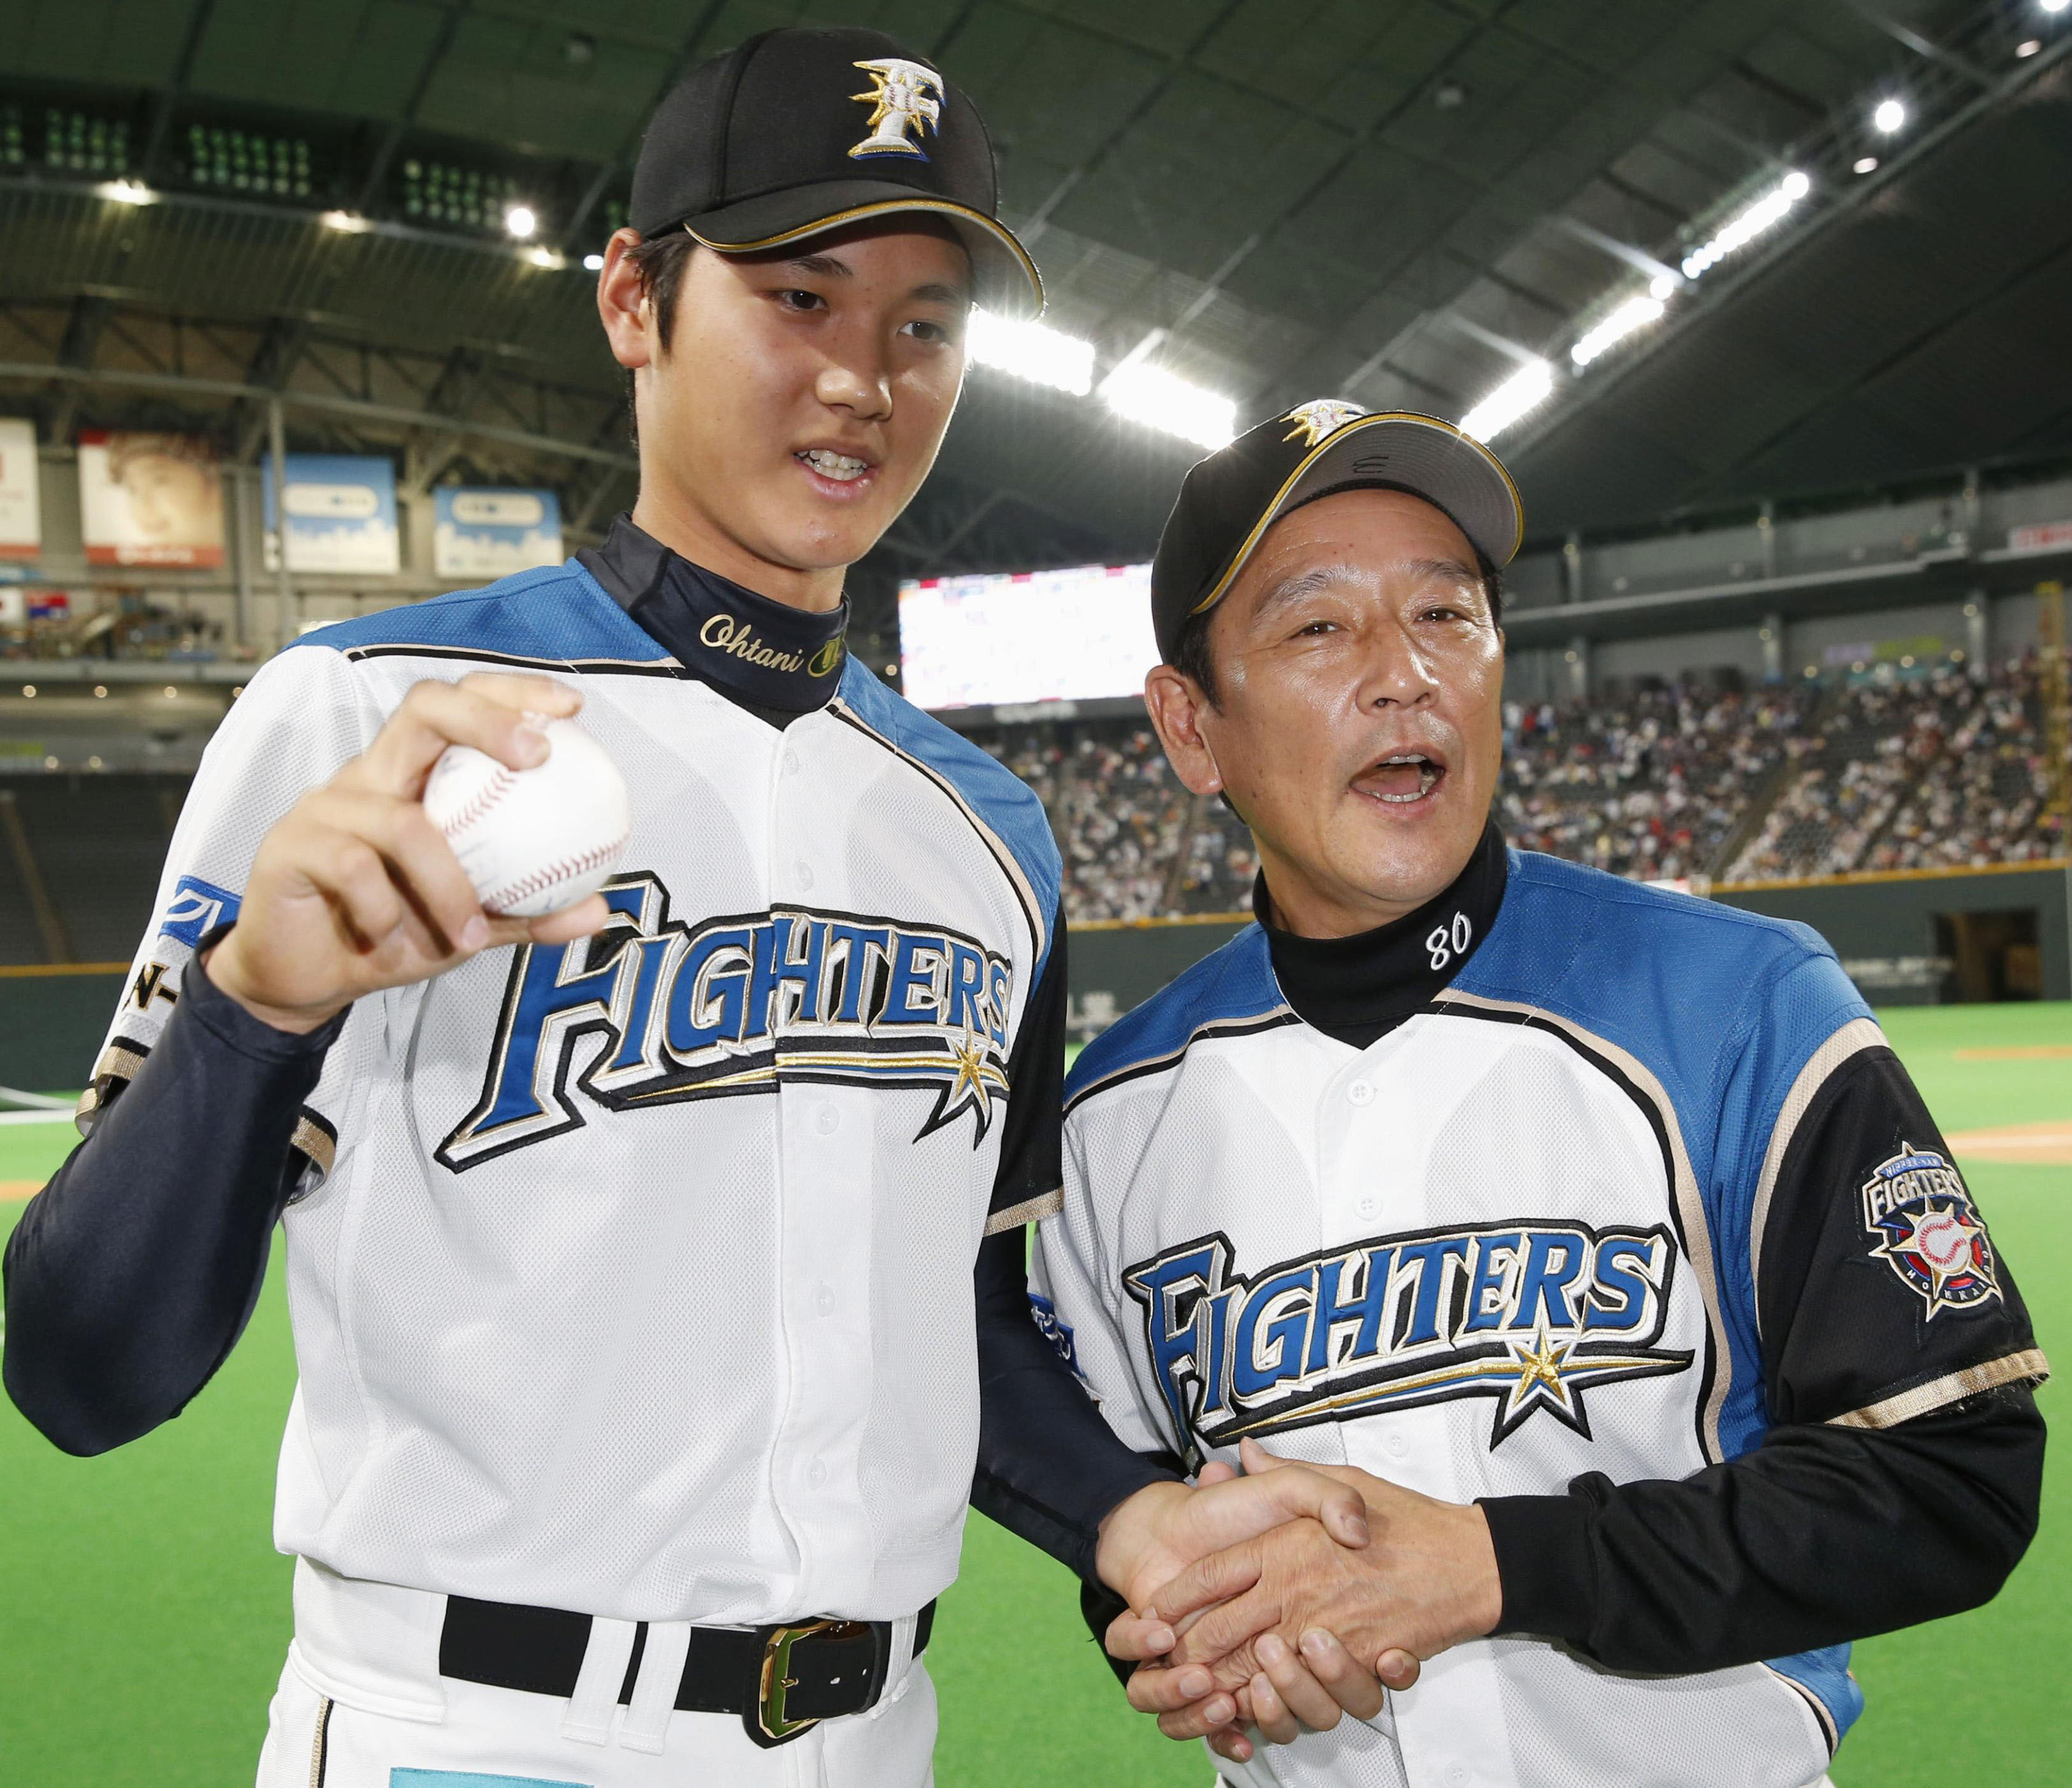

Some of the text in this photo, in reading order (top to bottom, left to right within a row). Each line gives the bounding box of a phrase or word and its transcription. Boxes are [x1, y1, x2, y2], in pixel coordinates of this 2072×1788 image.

[848, 58, 946, 162] F
[700, 614, 804, 673] Ohtani
[1425, 911, 1472, 970] 80
[433, 870, 1013, 1174] FIGHTERS
[1867, 1169, 1966, 1225] FIGHTERS
[1123, 1218, 1678, 1476] FIGHTERS
